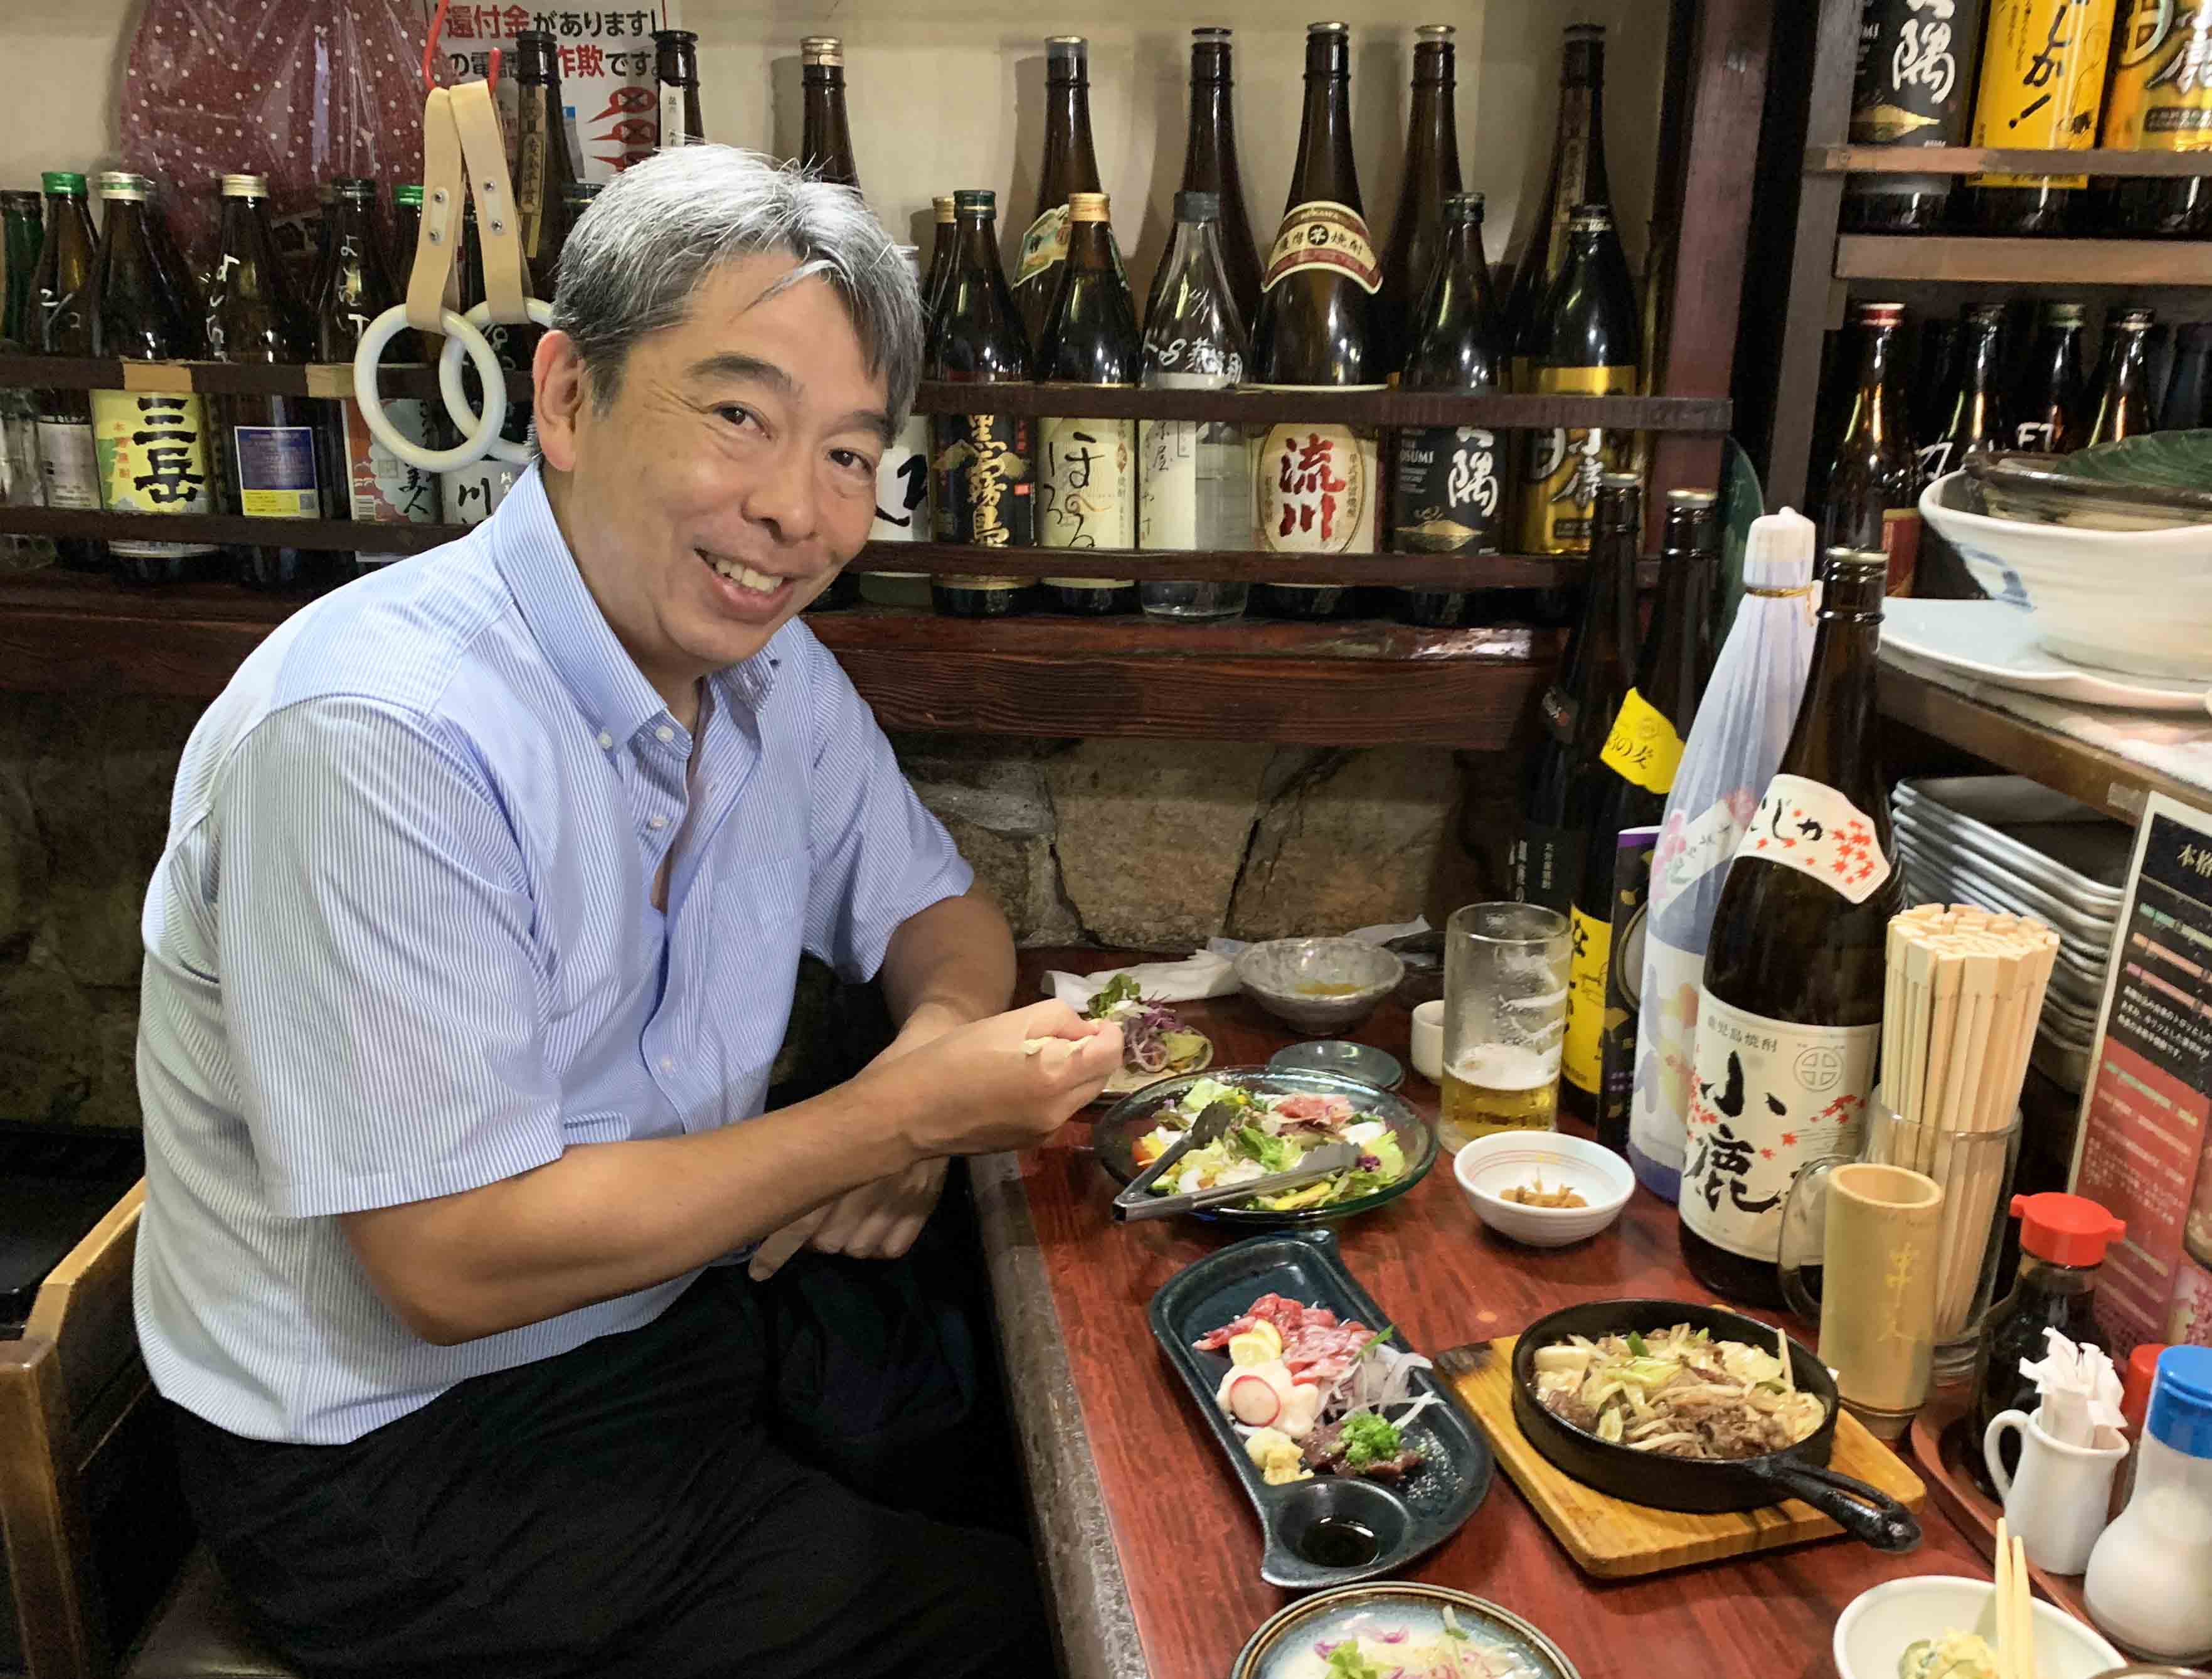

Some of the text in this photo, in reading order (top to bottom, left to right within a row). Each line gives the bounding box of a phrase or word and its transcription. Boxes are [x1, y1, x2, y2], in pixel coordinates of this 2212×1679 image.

[132, 397, 205, 503] 三岳
[459, 477, 492, 523] 川
[966, 415, 1010, 548] 黒霧島
[1279, 433, 1346, 542] 流川
